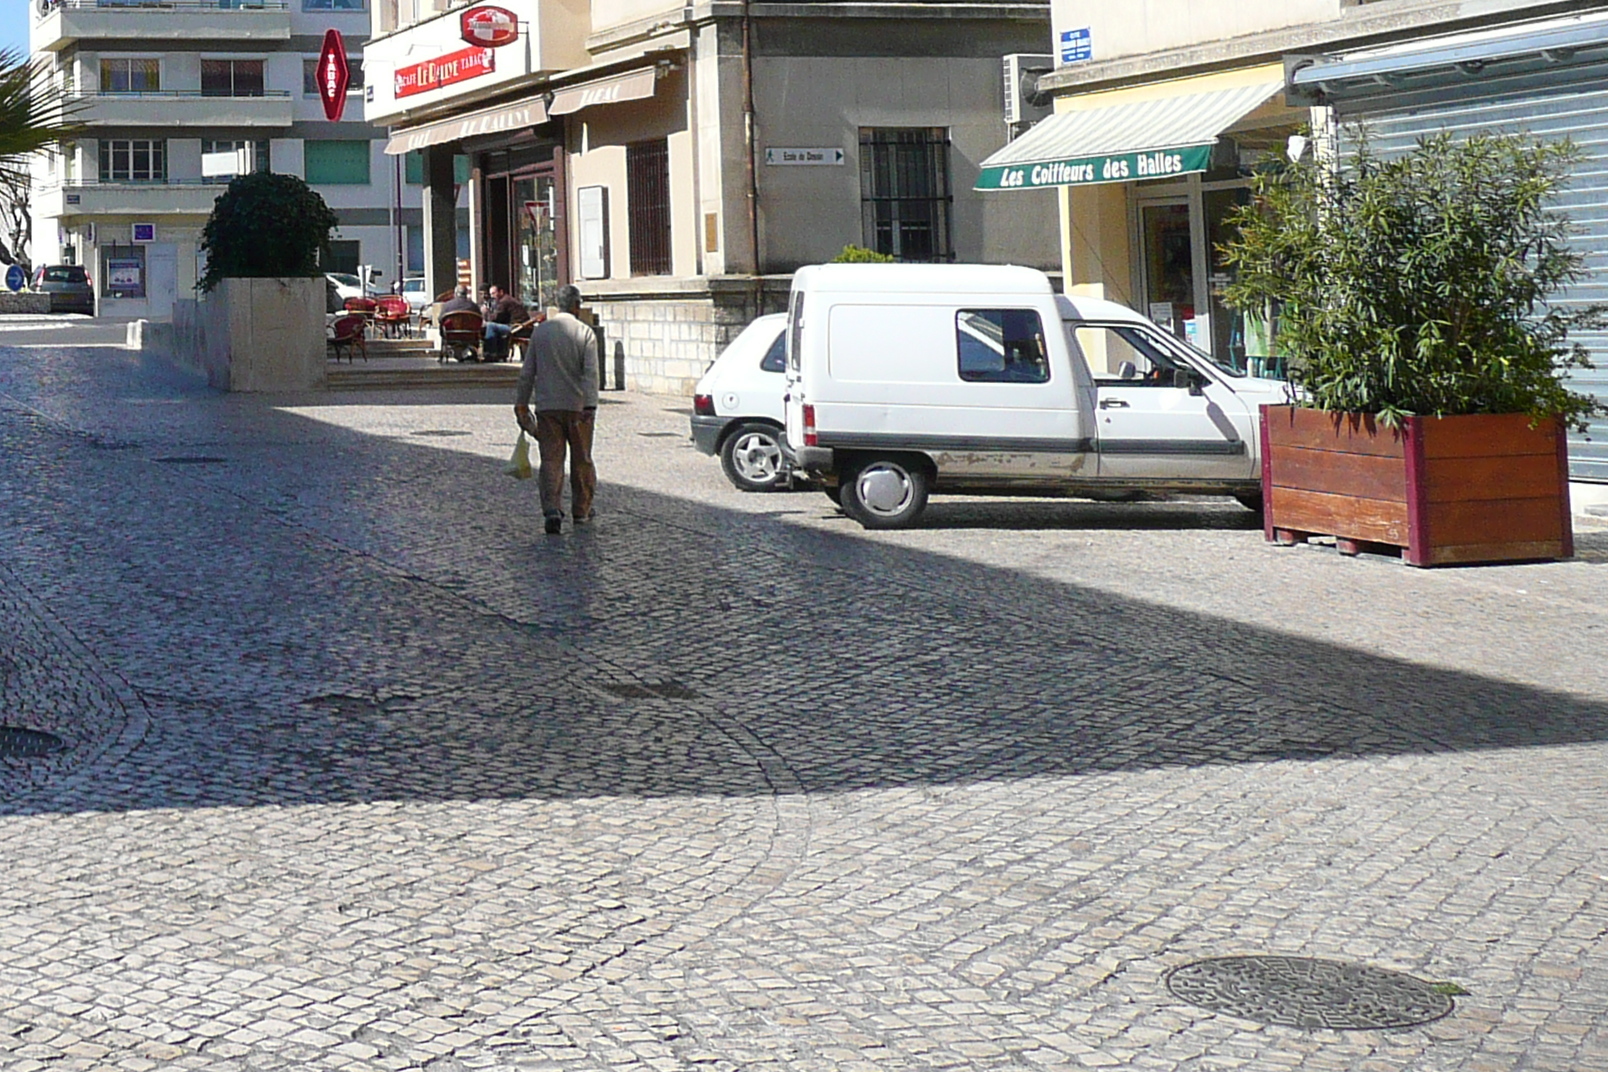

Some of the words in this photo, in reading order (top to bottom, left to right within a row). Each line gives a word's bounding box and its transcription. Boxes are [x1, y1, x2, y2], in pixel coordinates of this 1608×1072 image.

[327, 53, 337, 98] TABAC
[1000, 168, 1024, 187] Les
[1031, 162, 1094, 185] Coiffeurs
[1103, 158, 1129, 178] des
[1137, 152, 1182, 175] Halles
